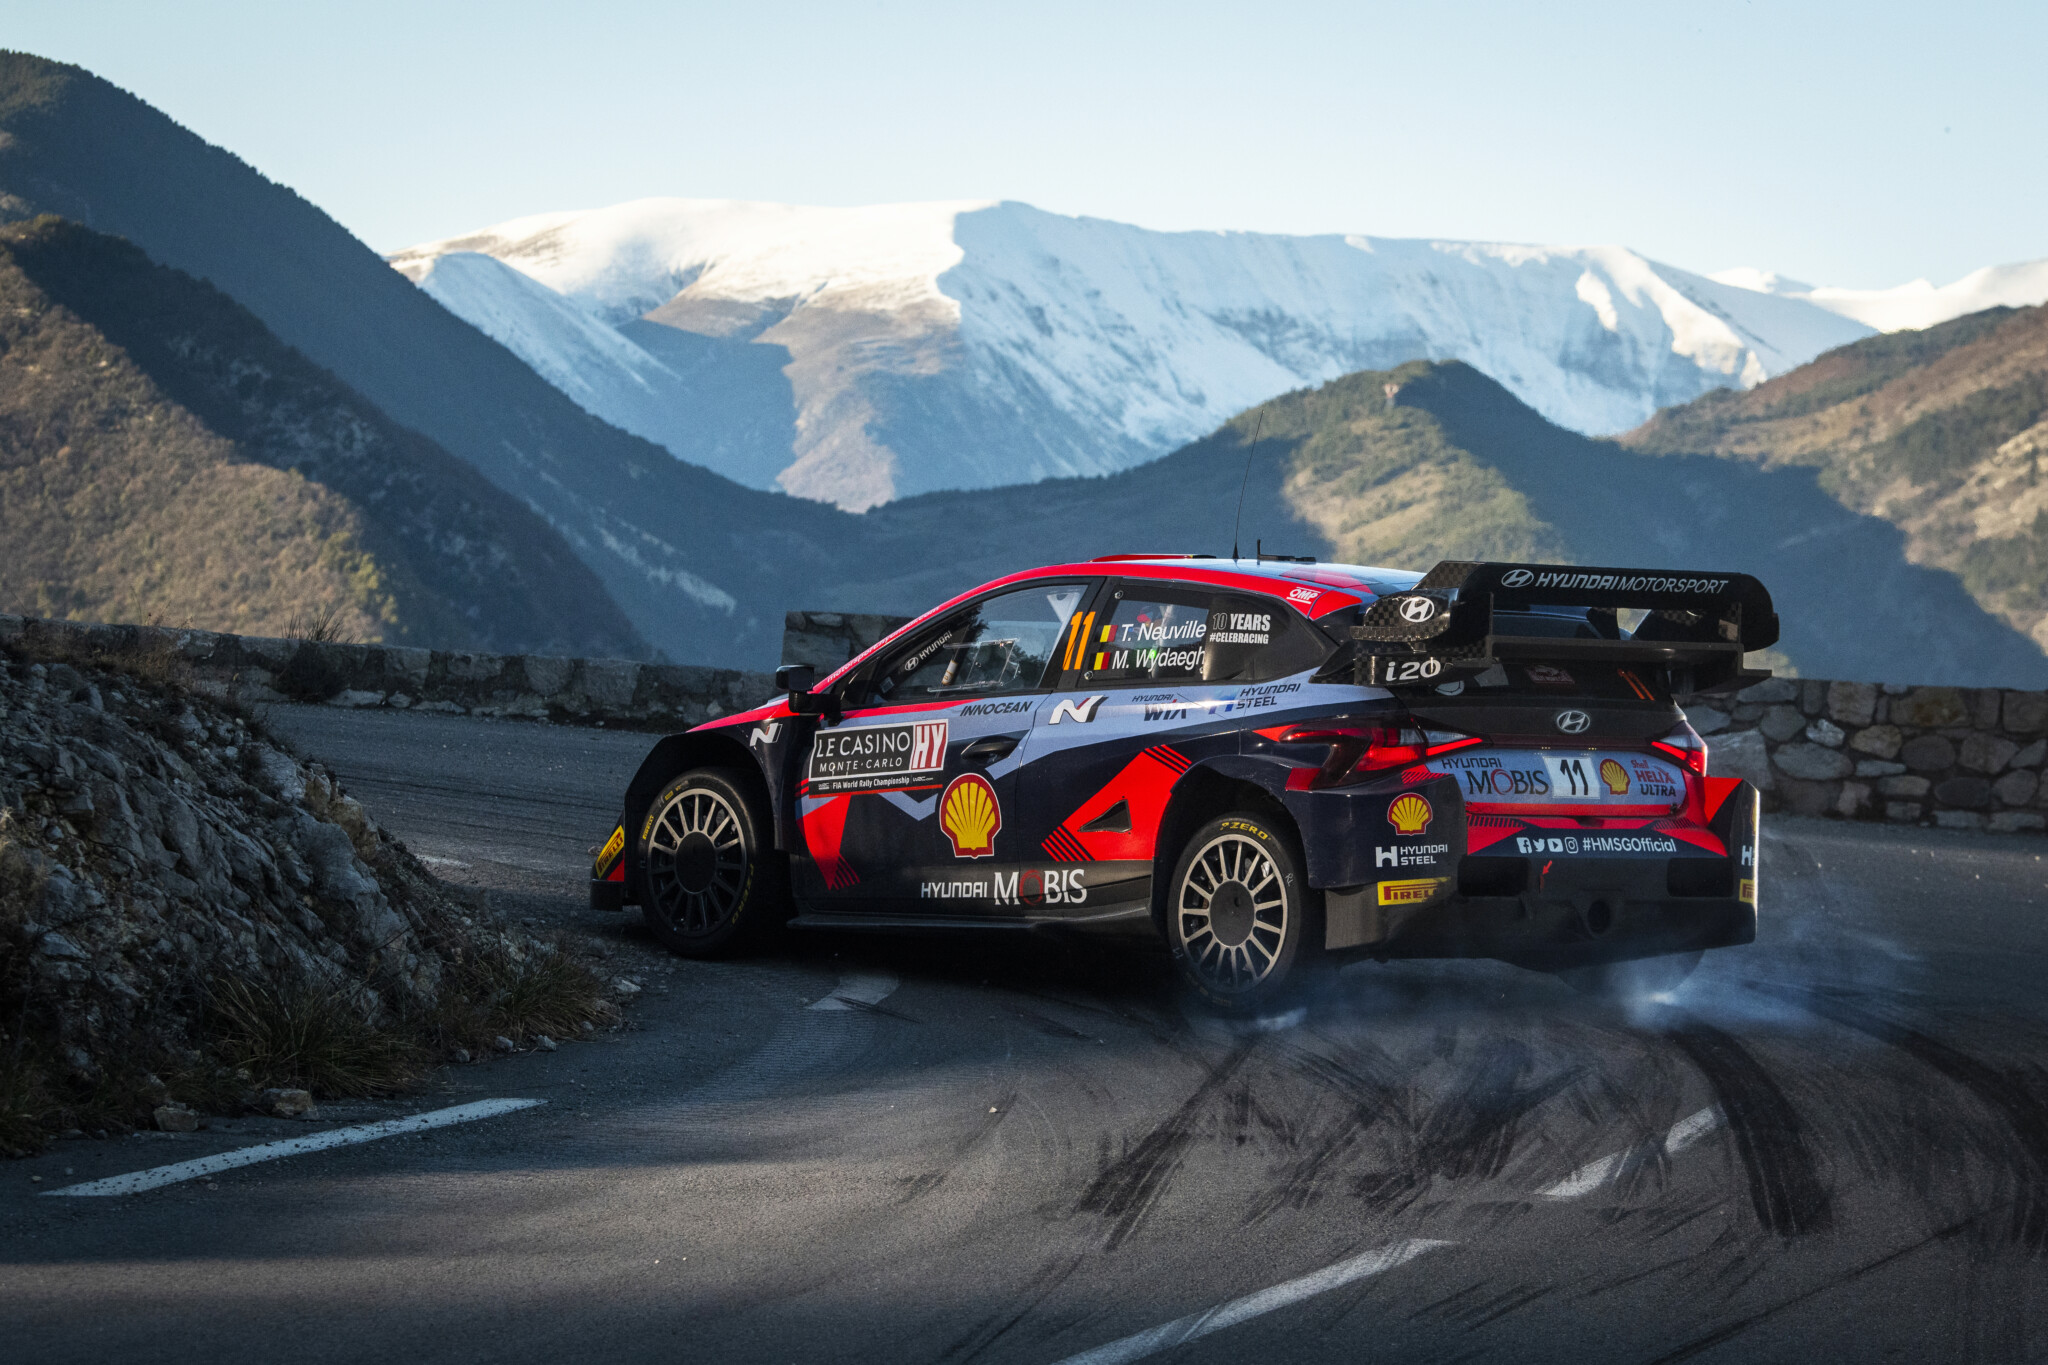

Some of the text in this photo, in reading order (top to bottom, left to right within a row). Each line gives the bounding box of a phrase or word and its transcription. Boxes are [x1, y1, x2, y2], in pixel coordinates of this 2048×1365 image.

[1535, 572, 1729, 594] HYUNDAI MOTORSPORT
[1289, 588, 1318, 601] OMP
[1121, 620, 1206, 642] T. Neuville
[1212, 613, 1271, 632] 10 YEARS
[919, 630, 953, 660] HYUNDAI
[1063, 611, 1096, 671] 11
[1209, 632, 1269, 645] #CELEBRACING
[1112, 646, 1205, 672] M. Wydaegh
[1386, 660, 1441, 681] i20
[1132, 694, 1174, 702] HYUNDAI
[1240, 683, 1301, 697] HYUNDAI
[960, 700, 1033, 717] INNOCEAN
[1236, 696, 1277, 710] STEEL
[816, 732, 911, 758] LE CASINO
[911, 724, 945, 769] HY
[1441, 758, 1503, 769] HYUNDAI
[843, 780, 858, 789] World
[860, 780, 872, 788] Rally
[874, 776, 910, 787] Championship
[1465, 768, 1549, 796] MOBIS
[1560, 759, 1589, 796] 11
[1634, 766, 1677, 784] HELIX
[1640, 784, 1676, 797] ULTRA
[1230, 822, 1268, 840] ZERO
[1400, 844, 1448, 856] HYUNDAI
[1582, 837, 1677, 852] #HMSGOfficial
[1400, 856, 1436, 866] STEEL
[921, 869, 1088, 906] HYUNDAI MOBIS
